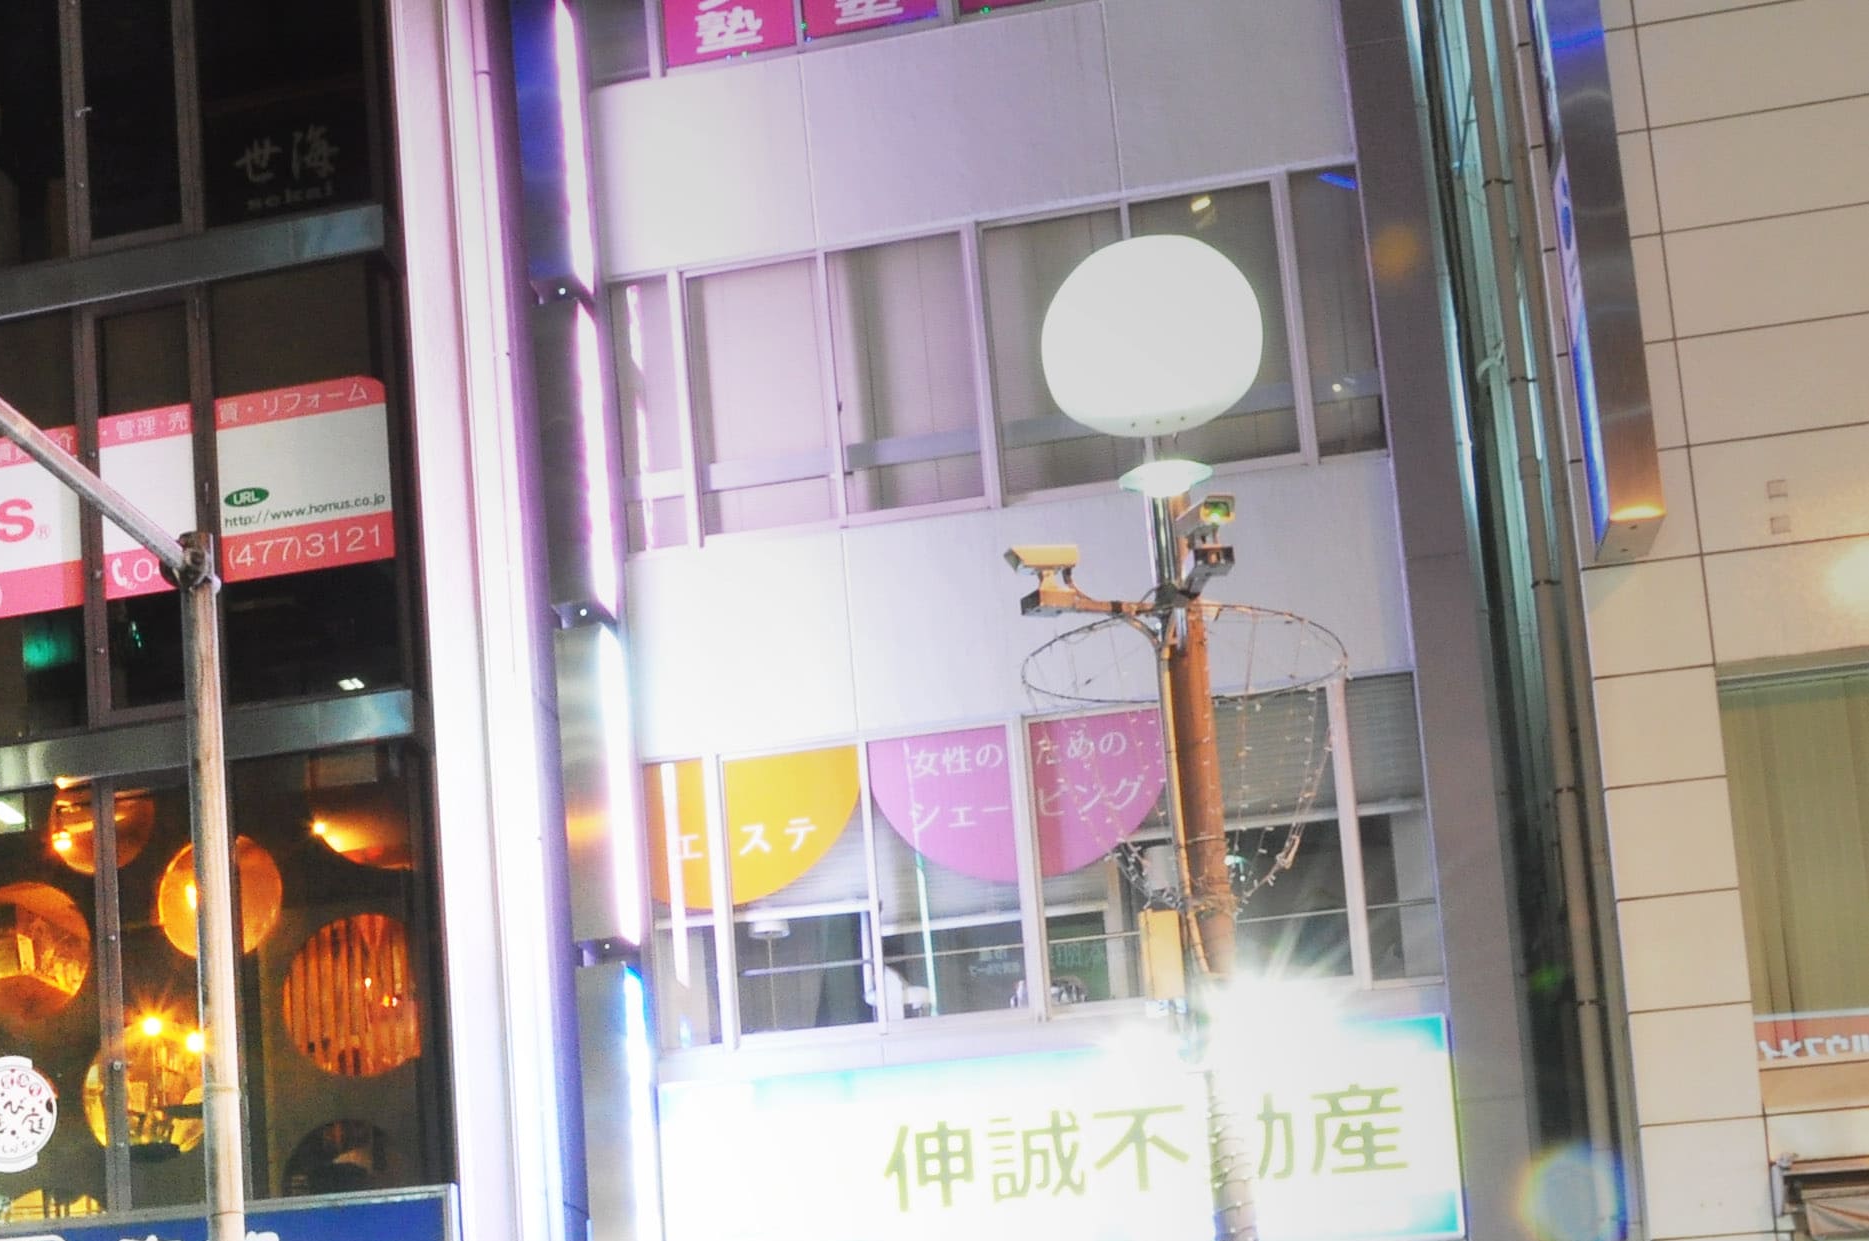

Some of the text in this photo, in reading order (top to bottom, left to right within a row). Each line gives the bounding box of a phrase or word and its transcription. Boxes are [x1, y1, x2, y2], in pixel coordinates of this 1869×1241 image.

[115, 412, 156, 441] 管理
[262, 382, 369, 414] リフォーム
[224, 491, 386, 529] http://www.homus.co.jp
[233, 489, 260, 506] URL
[228, 523, 383, 568] (477)3121
[910, 729, 1127, 779] 女性のための
[909, 774, 1145, 833] シェービング
